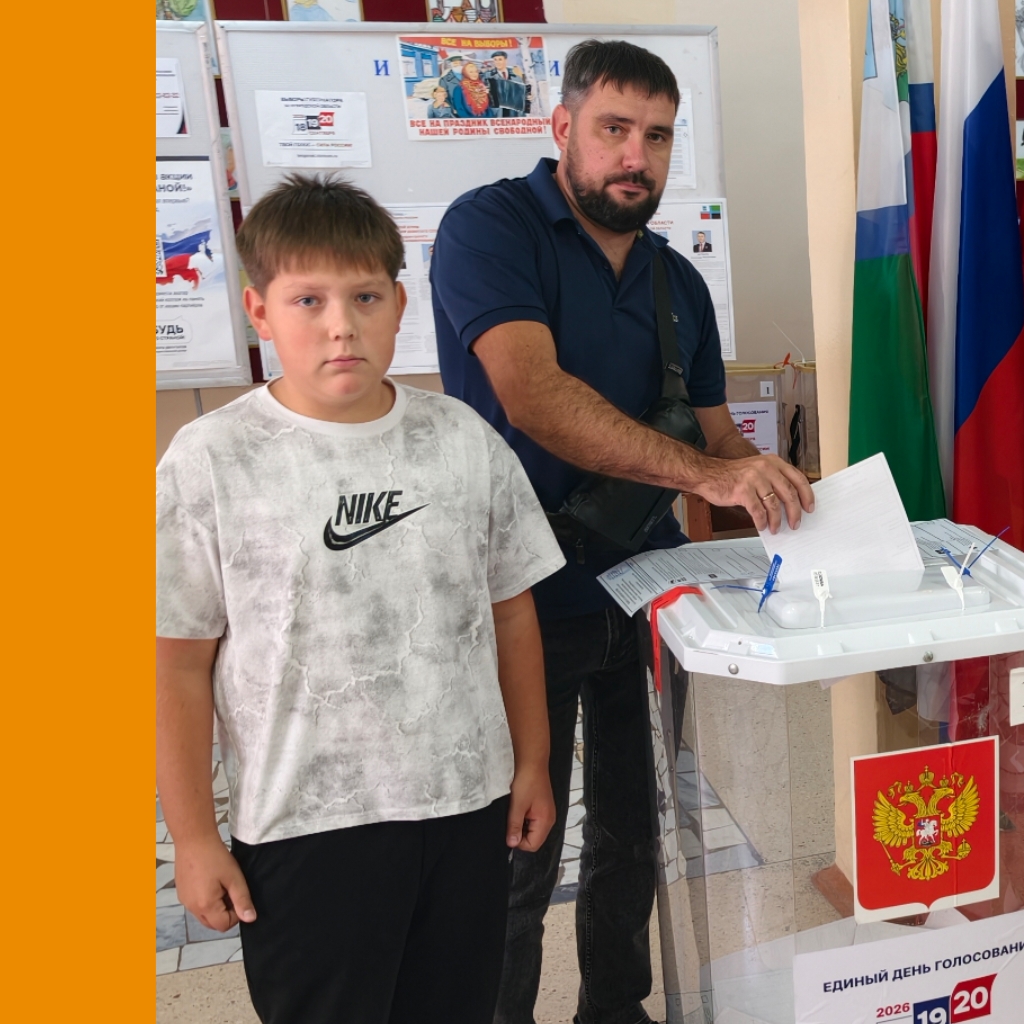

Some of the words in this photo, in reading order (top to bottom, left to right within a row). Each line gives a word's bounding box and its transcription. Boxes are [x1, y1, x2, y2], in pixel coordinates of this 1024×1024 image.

[461, 39, 473, 47] НА
[410, 119, 427, 128] ВСЕ
[429, 119, 441, 127] НА
[443, 119, 489, 128] ПРАЗДНИК
[490, 117, 551, 127] ВСЕНАРОДНЫЙ
[419, 127, 450, 136] НАШЕЙ
[453, 127, 490, 136] РОДИНЫ
[742, 422, 754, 431] 20
[335, 490, 403, 526] NIKE
[823, 969, 889, 993] ЕДИНЫЙ
[892, 963, 931, 982] ДЕНЬ
[953, 986, 989, 1015] 20
[876, 1002, 910, 1019] 2026
